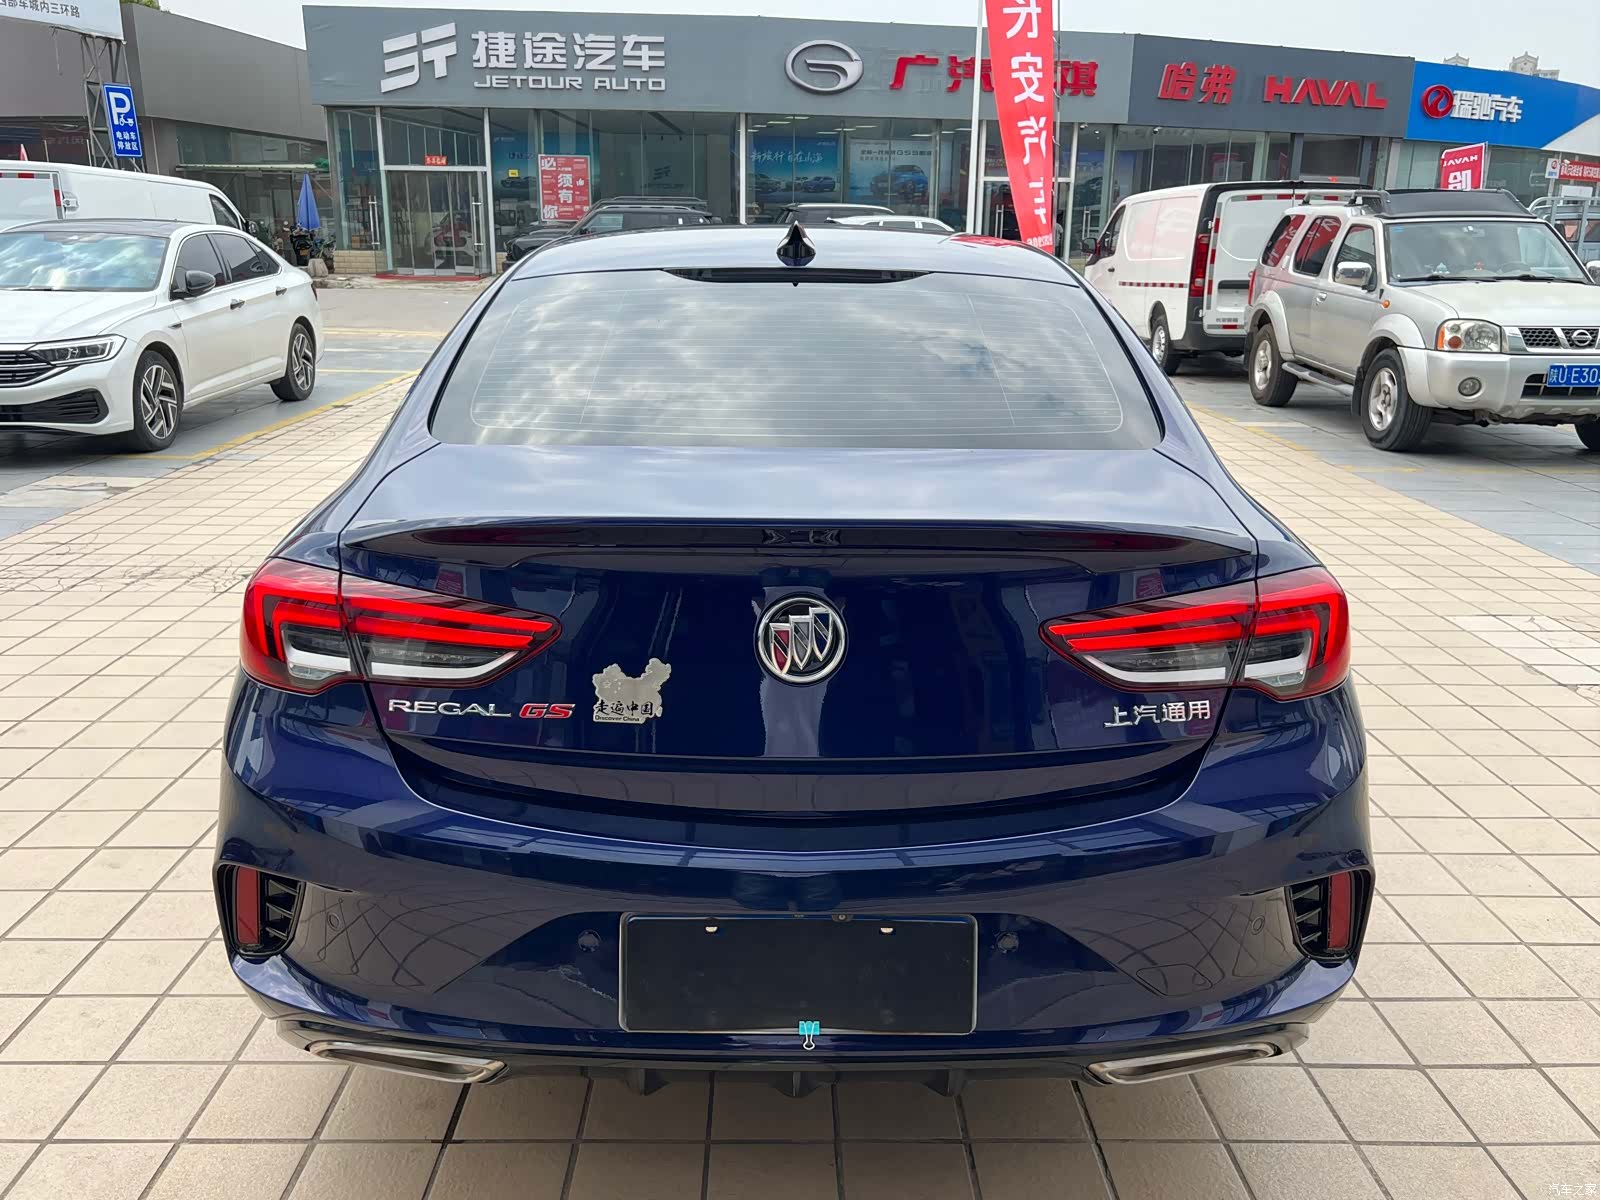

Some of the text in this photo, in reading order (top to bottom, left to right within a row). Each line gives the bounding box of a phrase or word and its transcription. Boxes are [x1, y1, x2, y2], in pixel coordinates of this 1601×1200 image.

[471, 31, 665, 71] 捷途汽车
[474, 75, 666, 91] JETOUR AUTO
[889, 54, 1099, 96] 广汽祺
[1157, 61, 1237, 104] 哈弗
[1264, 75, 1388, 109] HAVAL
[108, 92, 131, 125] P
[1450, 90, 1524, 123] 瑞驰汽车
[116, 131, 137, 140] 电动车
[117, 141, 139, 150] 停放区
[541, 157, 556, 170] 必
[557, 173, 573, 204] 须有
[544, 204, 559, 219] 你
[1549, 367, 1600, 384] 陕U·E30
[388, 699, 576, 719] REGAL GS
[595, 699, 653, 716] 走遍中国
[1104, 700, 1211, 728] 上汽通用
